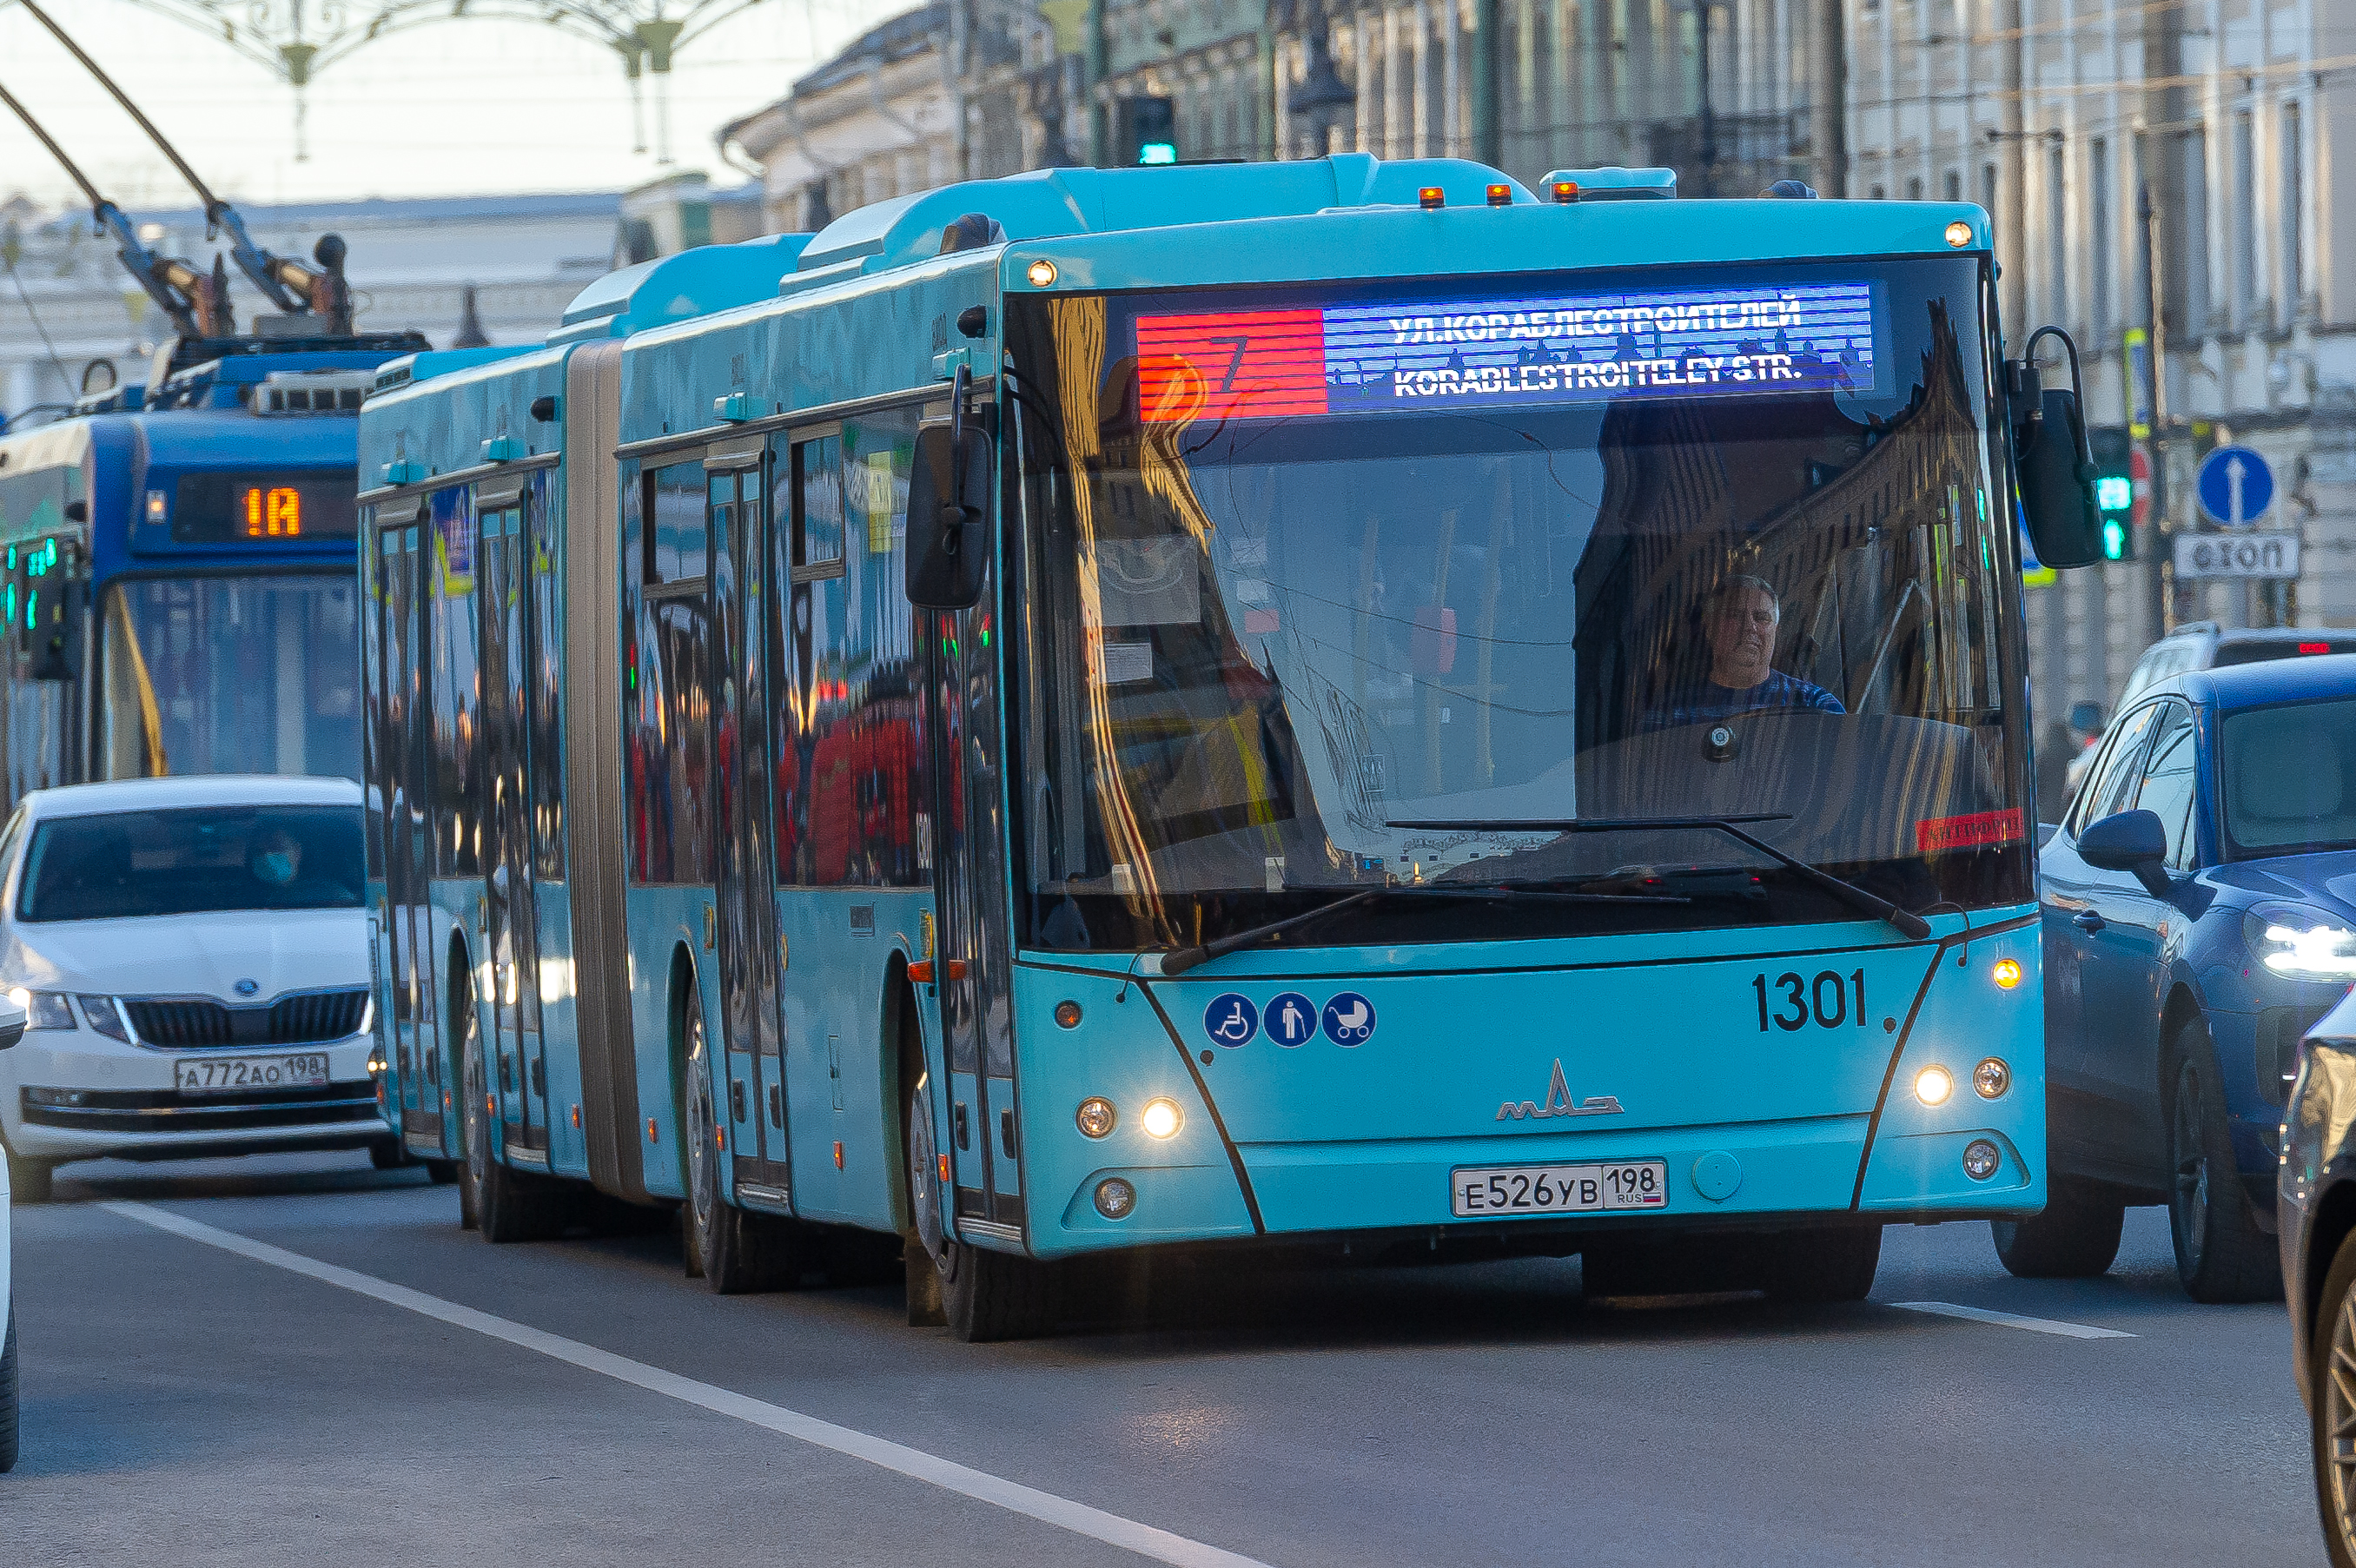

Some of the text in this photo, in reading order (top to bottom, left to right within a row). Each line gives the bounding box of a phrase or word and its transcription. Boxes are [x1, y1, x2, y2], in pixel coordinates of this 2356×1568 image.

[1209, 334, 1248, 393] 7
[1732, 354, 1803, 382] STR.
[1751, 967, 1867, 1032] 1301
[1466, 1167, 1656, 1210] Е526УВ 198
[1618, 1193, 1643, 1205] RUS
